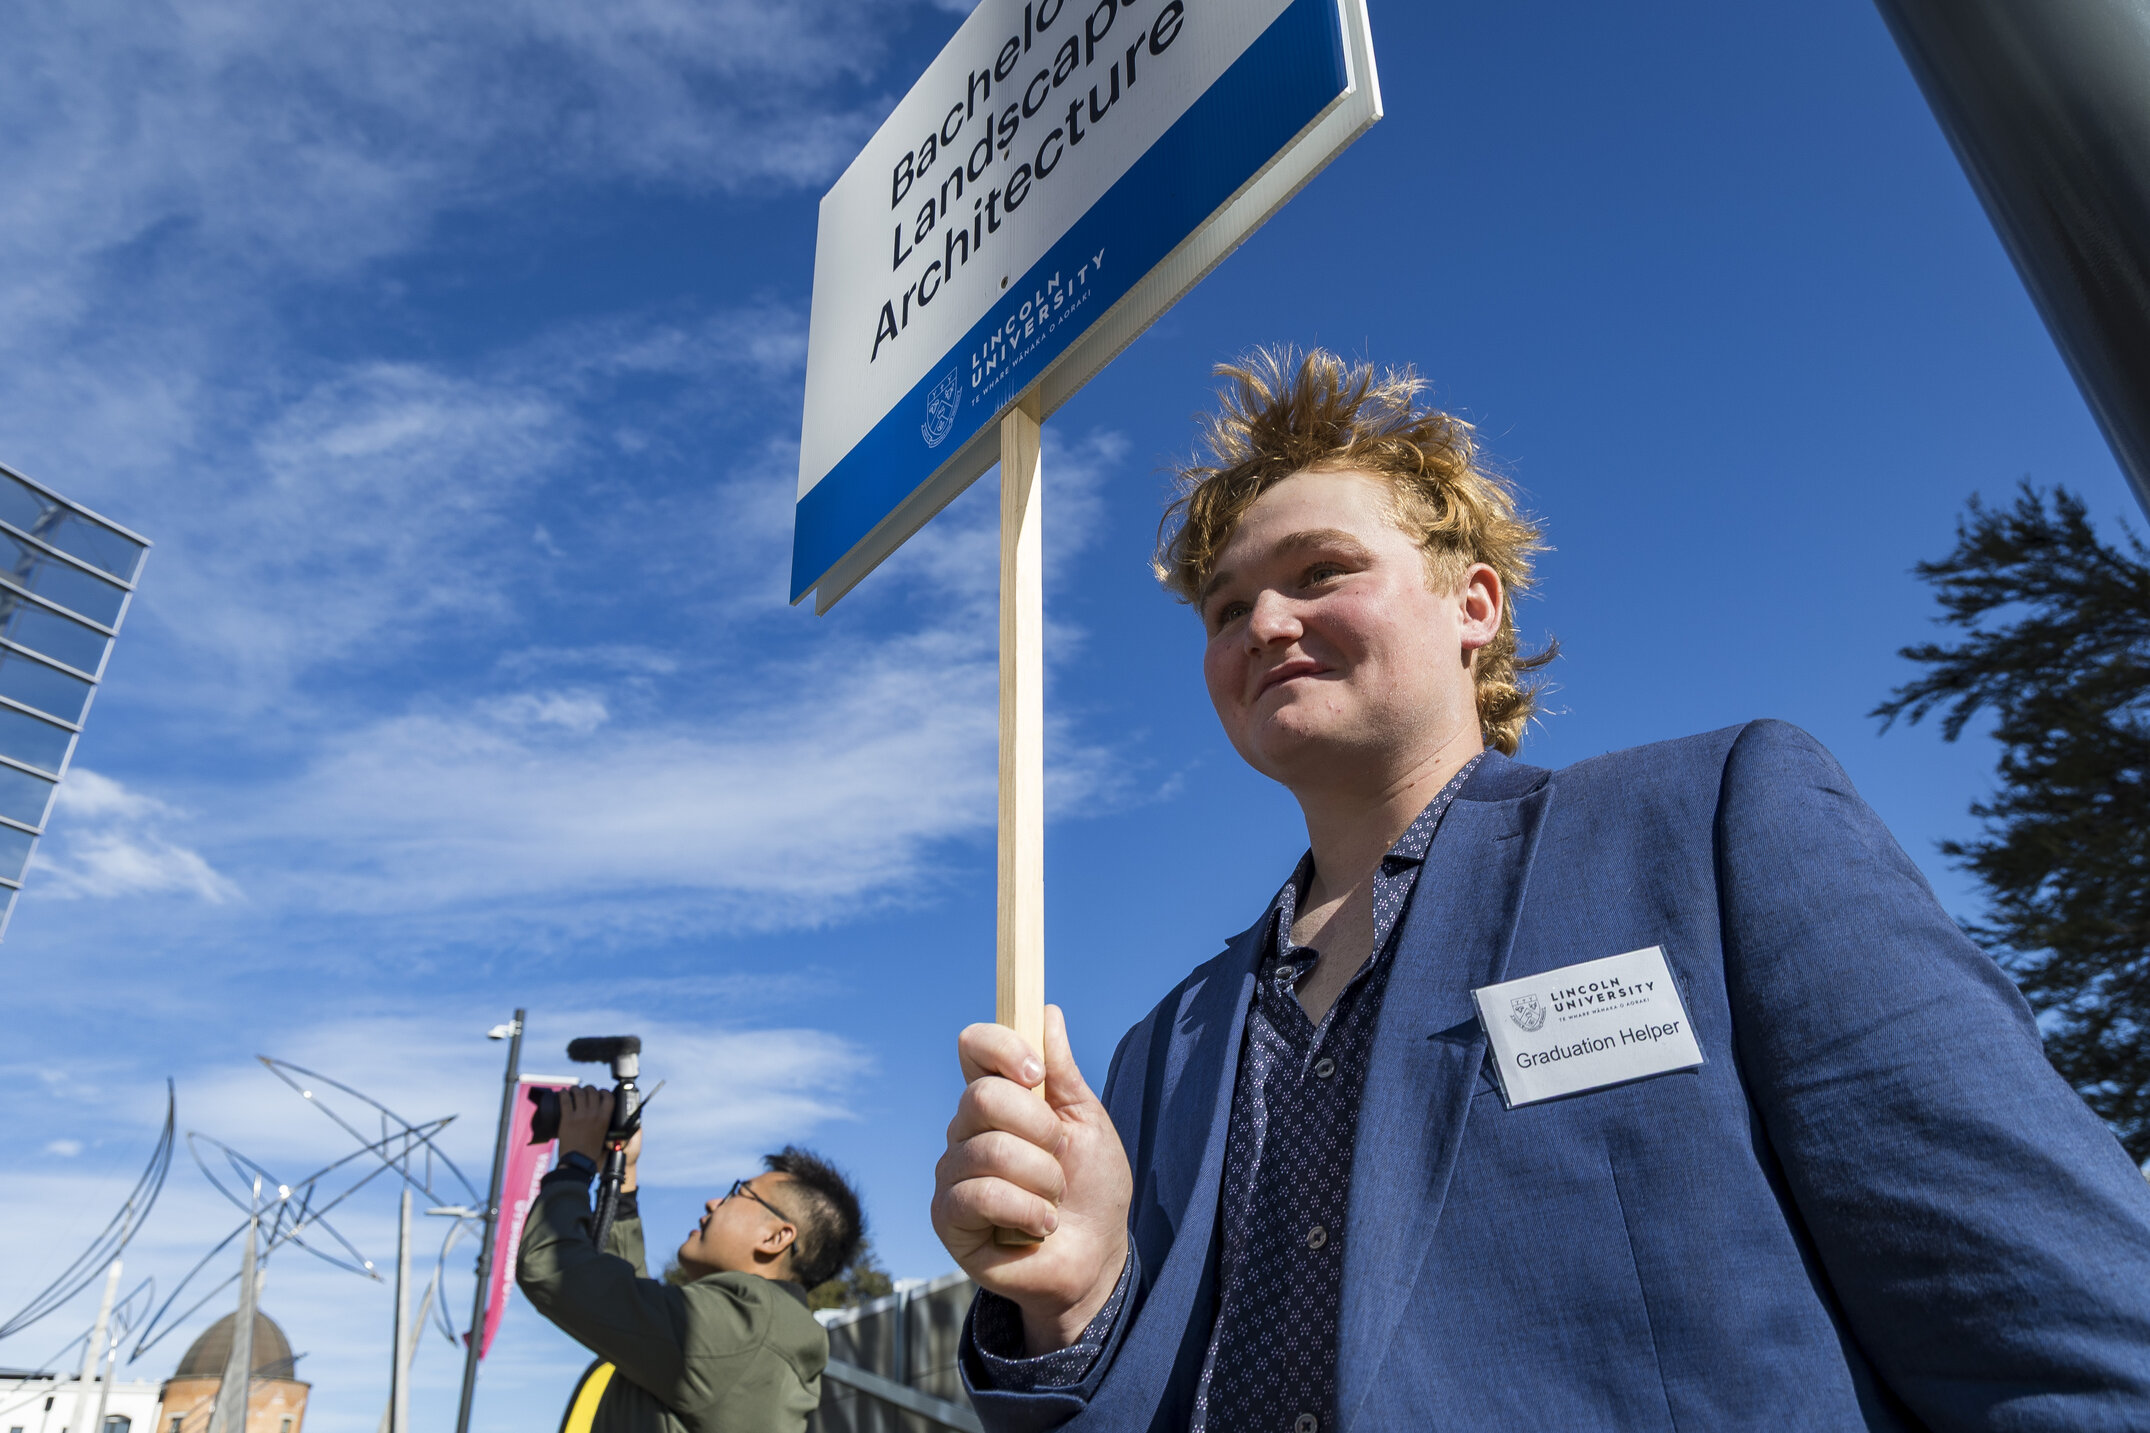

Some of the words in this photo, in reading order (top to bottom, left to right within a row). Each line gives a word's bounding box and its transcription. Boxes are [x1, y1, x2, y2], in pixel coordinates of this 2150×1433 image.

[891, 0, 1071, 211] Bachelo
[870, 0, 1185, 364] Architecture
[971, 247, 1105, 389] UNIVERSITY
[971, 394, 981, 407] TE
[983, 366, 1010, 396] WHARE
[1049, 323, 1056, 333] O
[1058, 289, 1091, 326] AORAKI
[972, 271, 1060, 370] LINCOLN
[1550, 977, 1620, 1002] LINCOLN
[1554, 981, 1655, 1013] UNIVERSITY
[1516, 1036, 1616, 1069] Graduation
[1619, 1020, 1680, 1046] Helper
